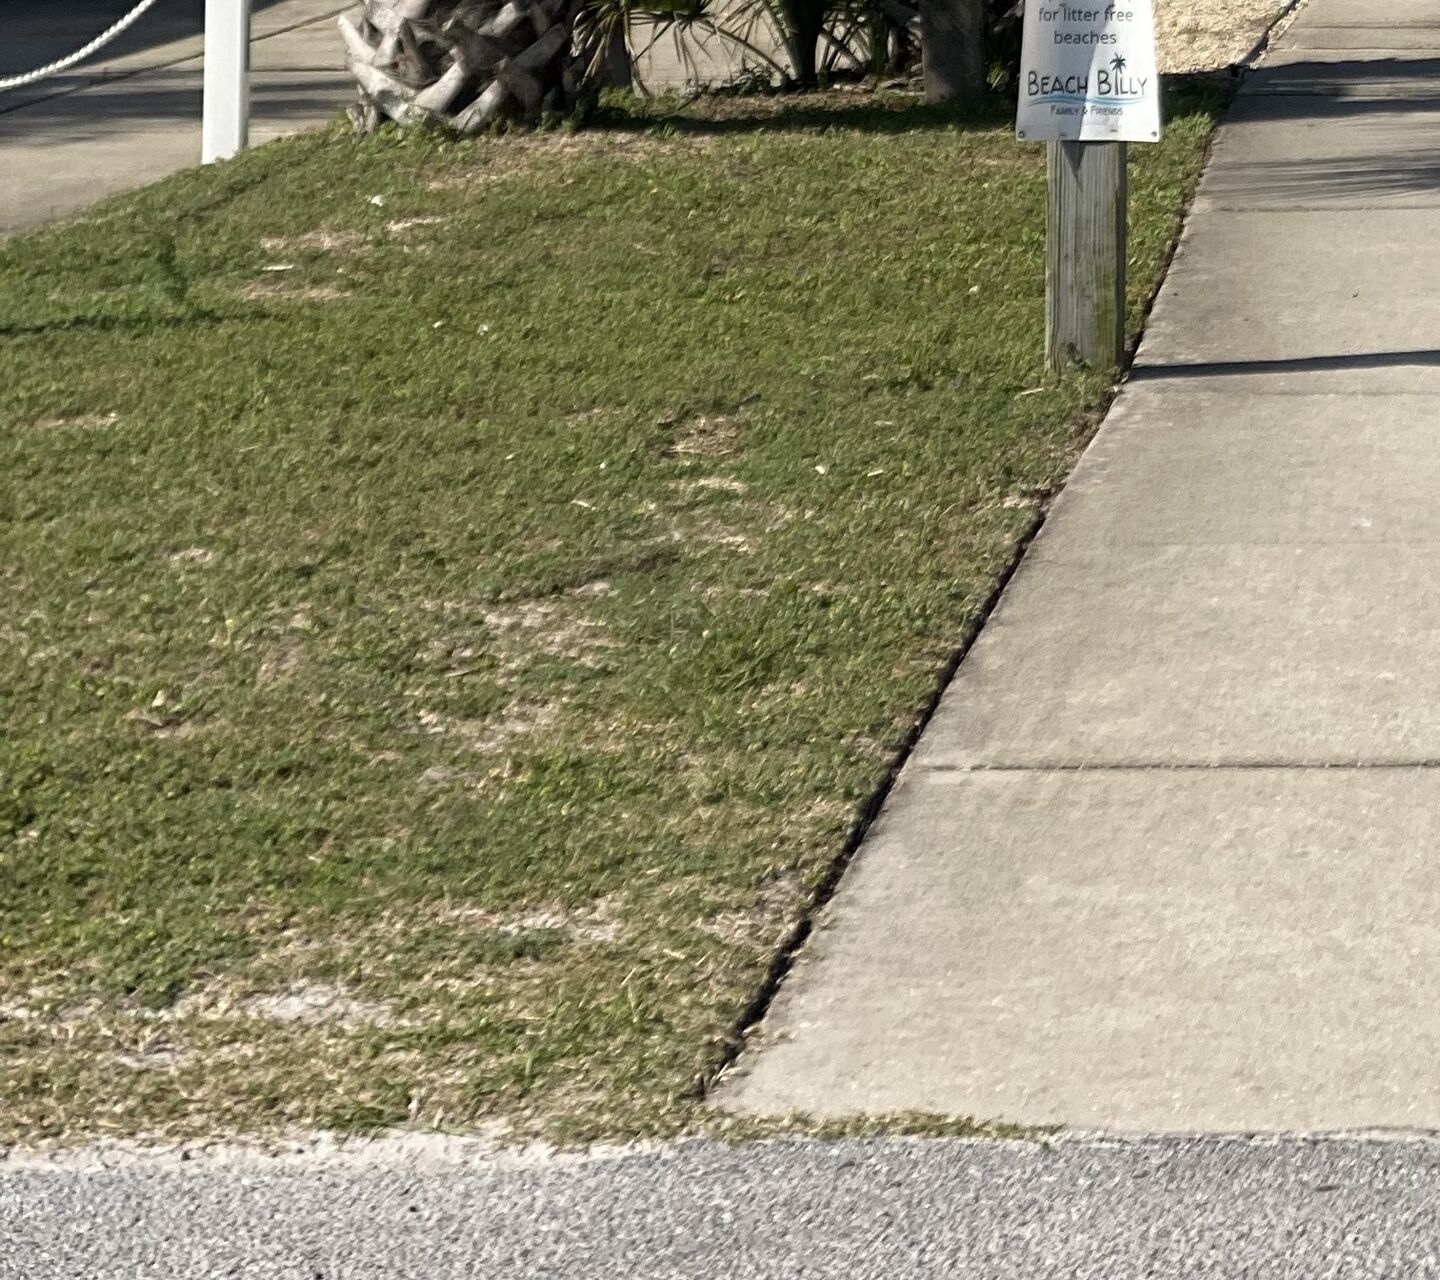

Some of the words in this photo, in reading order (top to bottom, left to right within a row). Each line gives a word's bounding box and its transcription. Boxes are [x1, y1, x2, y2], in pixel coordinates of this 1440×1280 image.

[1038, 7, 1059, 23] for
[1062, 5, 1099, 23] litter
[1103, 6, 1133, 22] free
[1053, 30, 1117, 45] beaches
[1027, 70, 1088, 96] BEACH
